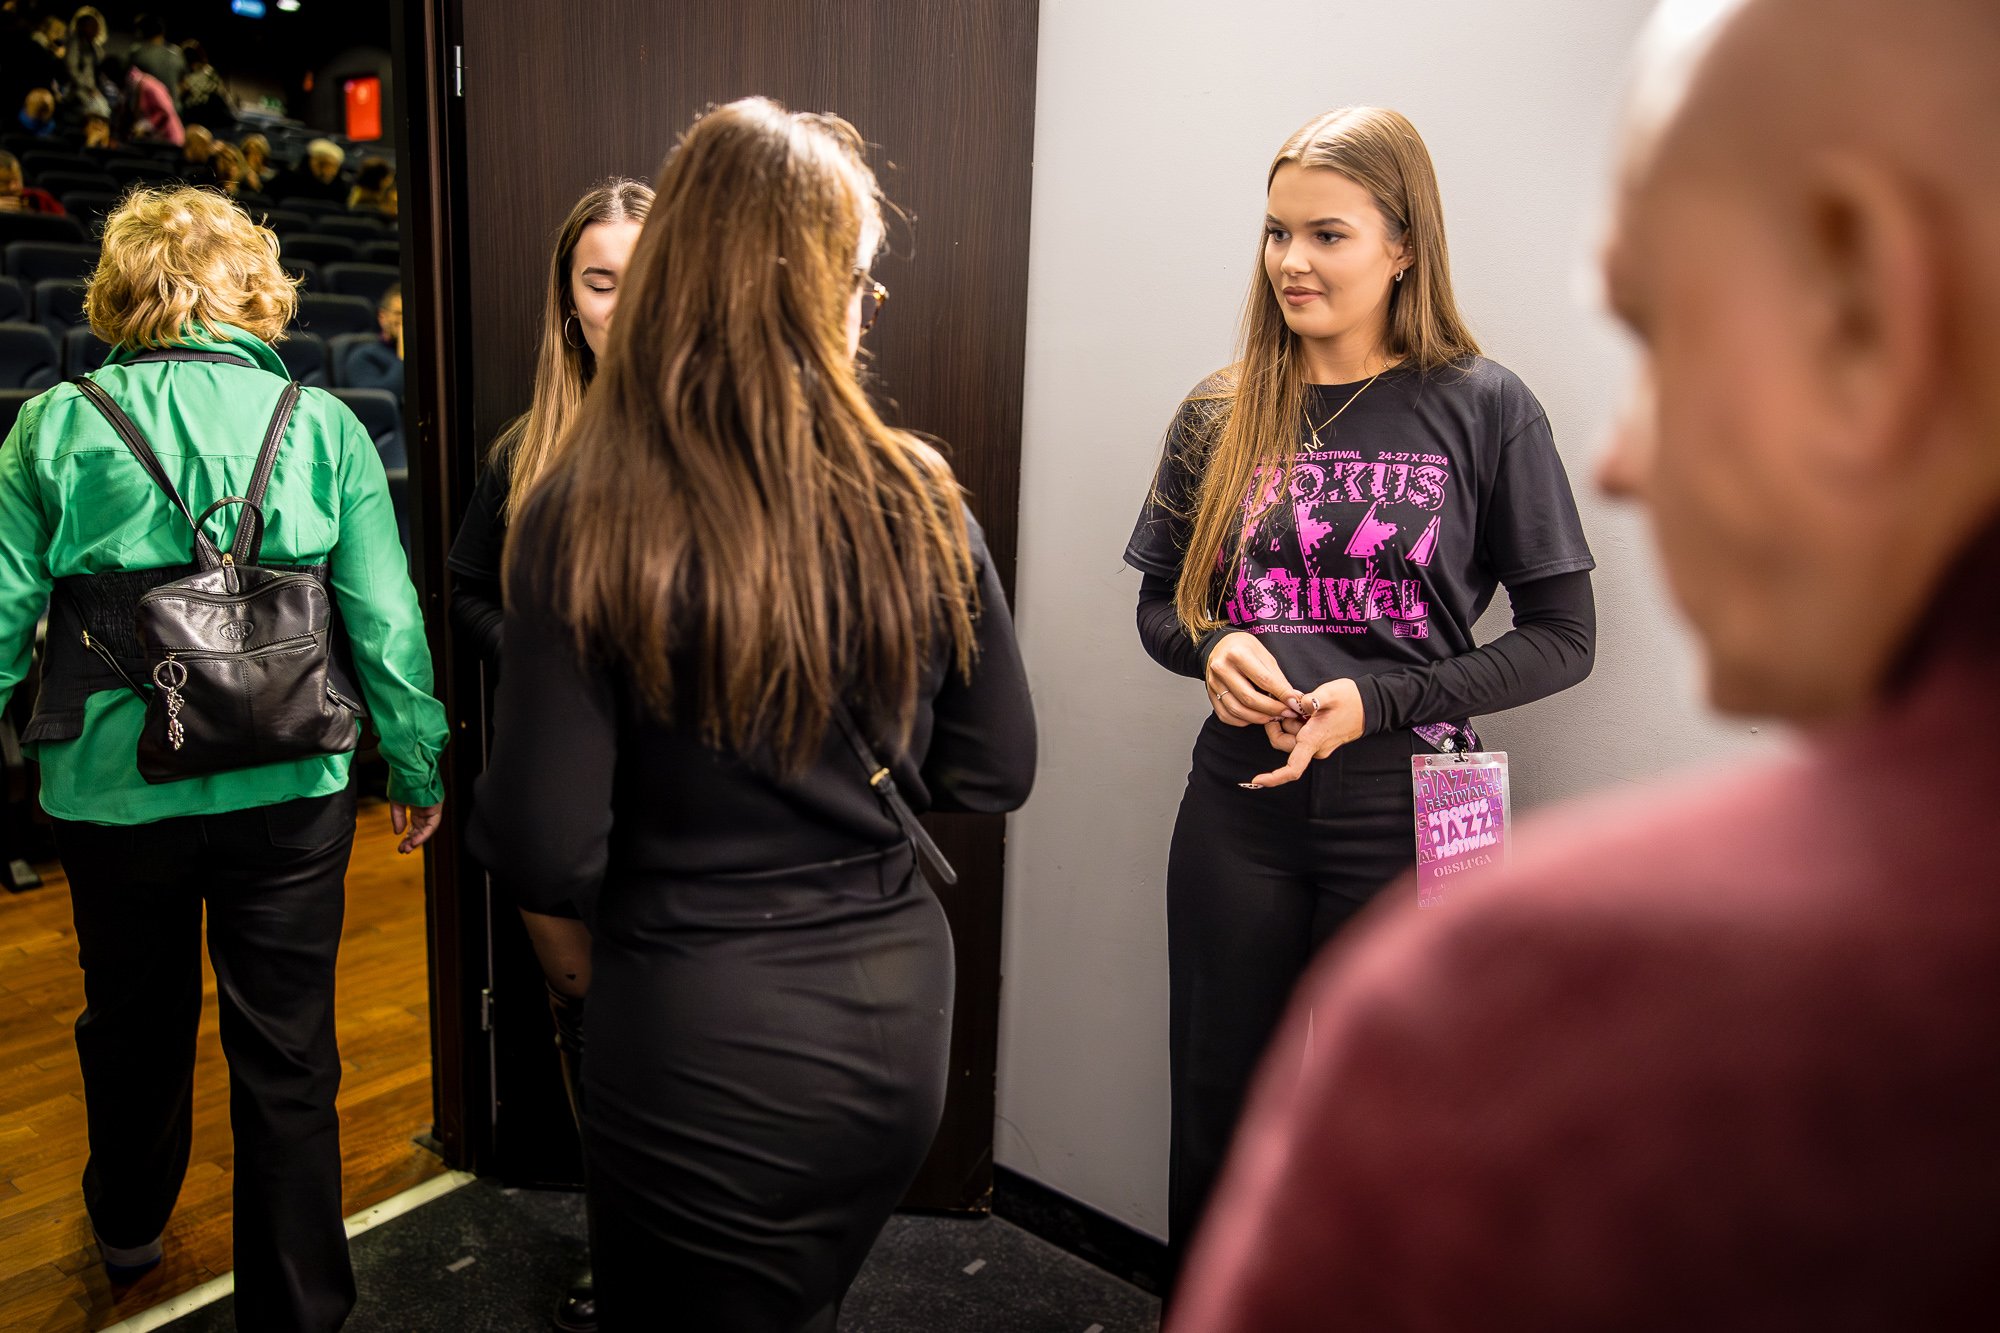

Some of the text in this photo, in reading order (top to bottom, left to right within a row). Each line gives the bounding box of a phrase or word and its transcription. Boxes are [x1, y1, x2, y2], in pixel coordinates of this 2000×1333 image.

[1309, 450, 1362, 461] FESTIWAL
[1378, 451, 1449, 466] 24-27 X 2024
[1243, 461, 1449, 511] ROKUS
[1279, 625, 1325, 634] CENTRUM
[1325, 625, 1368, 635] KULTURY
[1427, 798, 1489, 828] KROKUS
[1429, 809, 1495, 848] JAZZ
[1435, 830, 1497, 860] FESTIWAL
